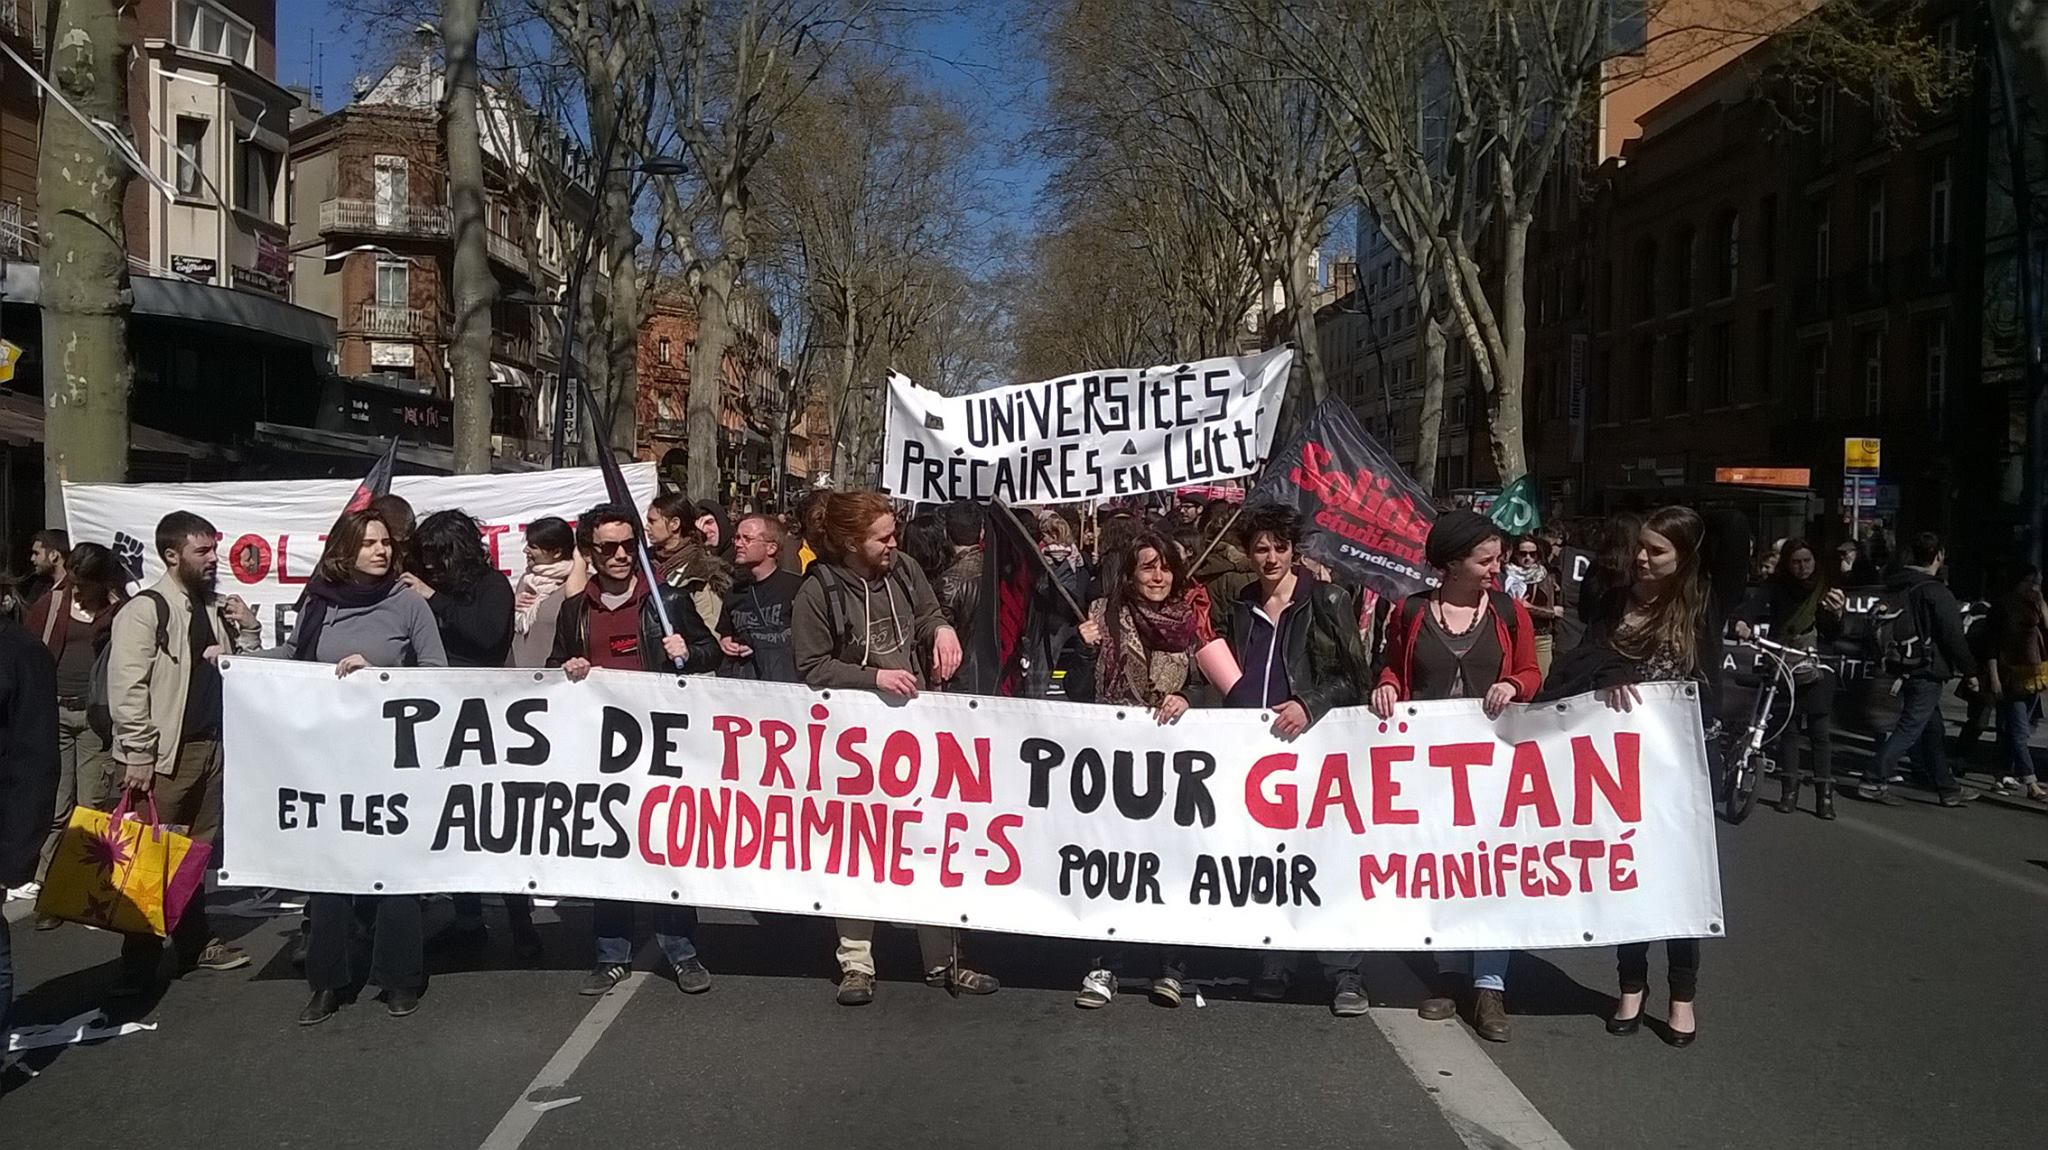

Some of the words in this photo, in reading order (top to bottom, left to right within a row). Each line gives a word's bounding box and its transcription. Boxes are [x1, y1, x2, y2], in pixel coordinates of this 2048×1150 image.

[1114, 464, 1151, 494] EN
[1339, 543, 1422, 580] syndicats
[381, 697, 551, 769] PAS
[599, 706, 690, 779] DE
[1020, 738, 1217, 828] POUR
[1245, 721, 1642, 834] GAËTAN
[278, 787, 326, 830] ET
[340, 793, 409, 835] LES
[431, 781, 631, 859] AUTRES
[1058, 844, 1165, 905] POUR
